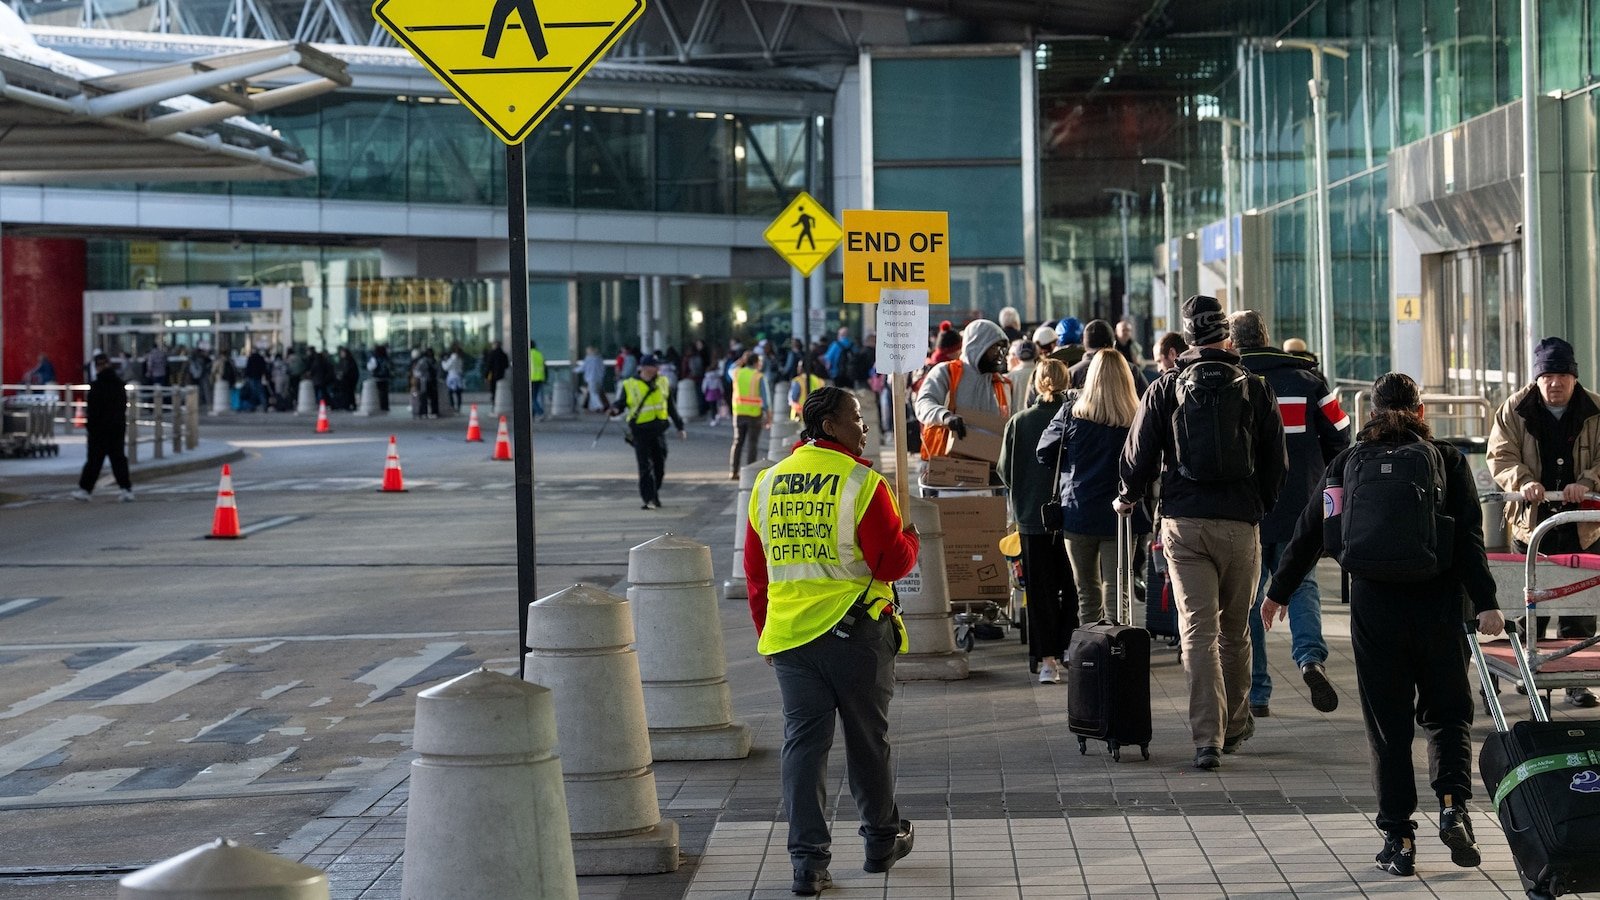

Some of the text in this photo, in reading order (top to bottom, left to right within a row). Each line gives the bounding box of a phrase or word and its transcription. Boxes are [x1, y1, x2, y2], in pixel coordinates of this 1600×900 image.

[847, 231, 944, 253] END OF
[868, 262, 925, 282] LINE
[1404, 299, 1412, 318] 4
[790, 473, 840, 496] BWI
[770, 501, 834, 518] AIRPORT
[771, 523, 833, 539] EMERGENCY
[772, 543, 836, 561] OFFICIAL
